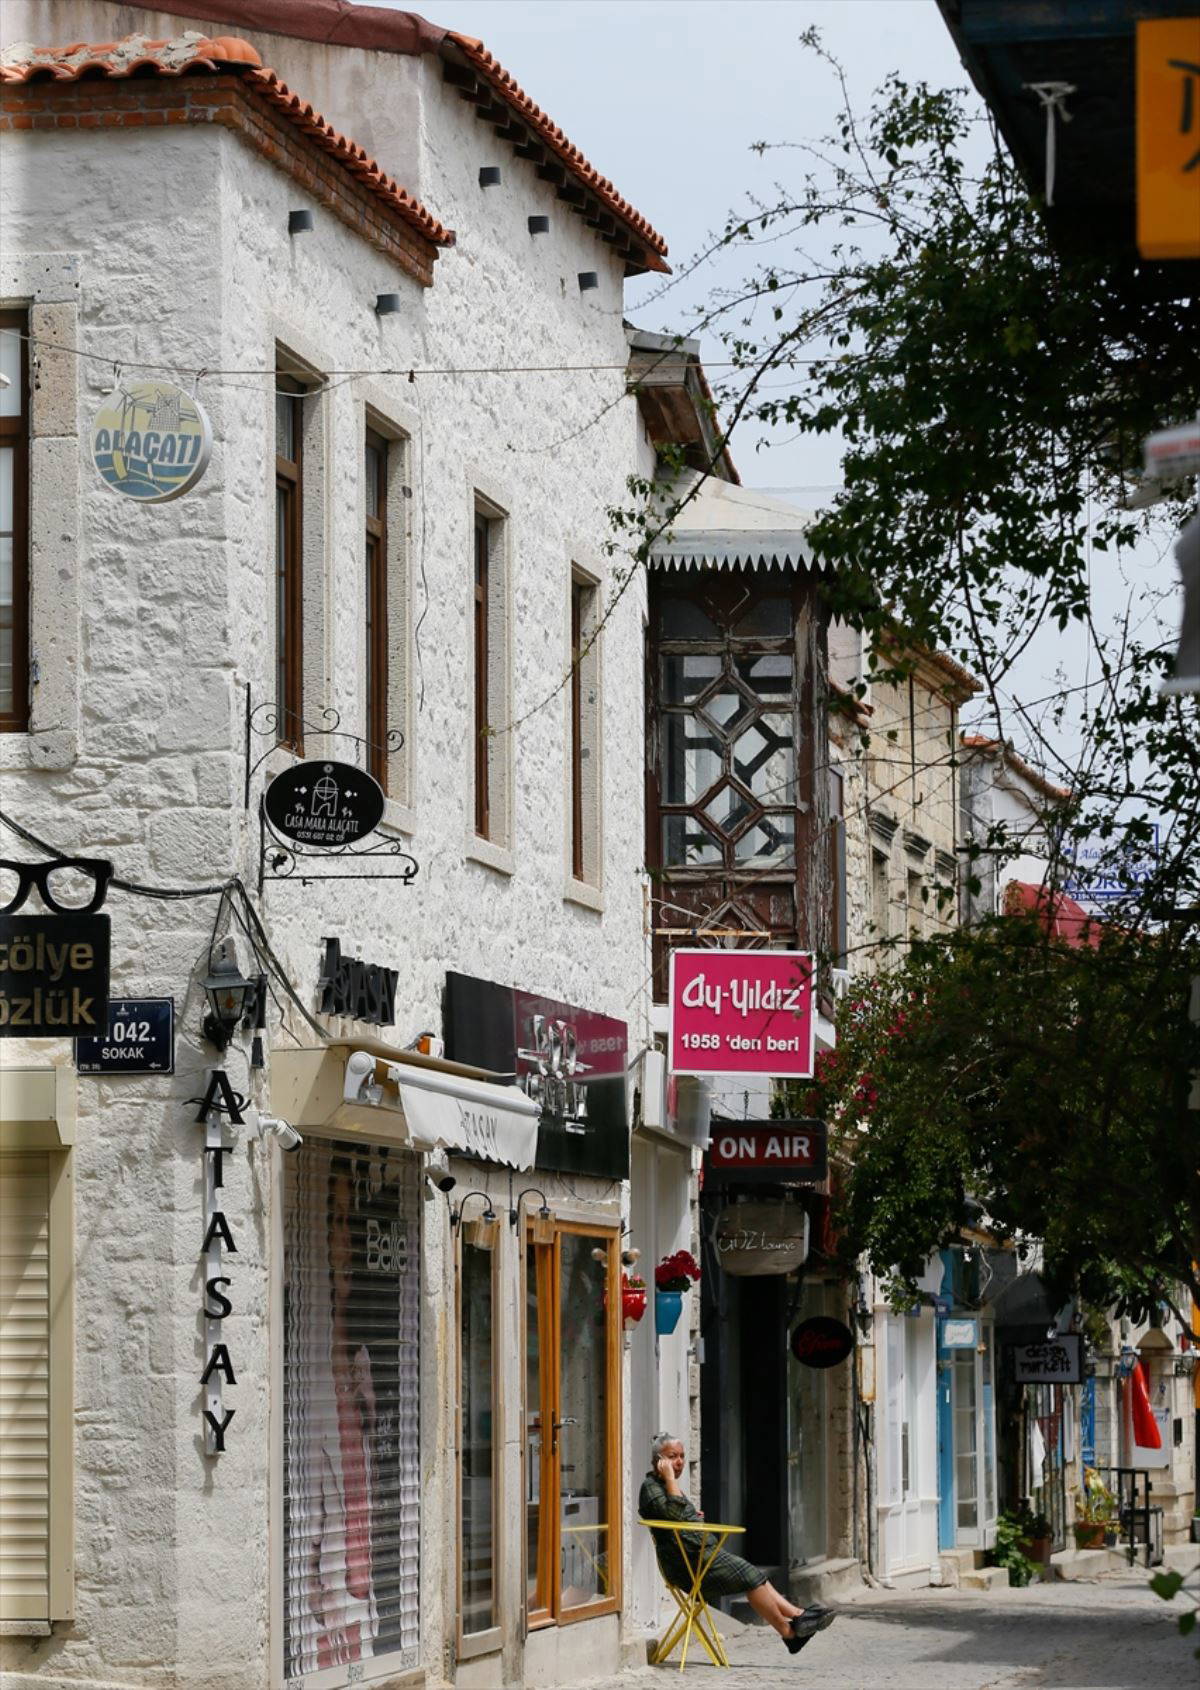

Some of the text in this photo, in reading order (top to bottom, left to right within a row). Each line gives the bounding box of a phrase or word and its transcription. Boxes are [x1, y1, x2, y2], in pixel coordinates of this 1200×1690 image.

[285, 813, 304, 829] CASA
[92, 1021, 156, 1043] 042.
[681, 1033, 721, 1049] 1958
[767, 1035, 799, 1051] beri
[102, 1047, 145, 1060] SOKAK
[719, 1136, 810, 1159] ON AIR
[192, 1069, 247, 1451] ATASAY
